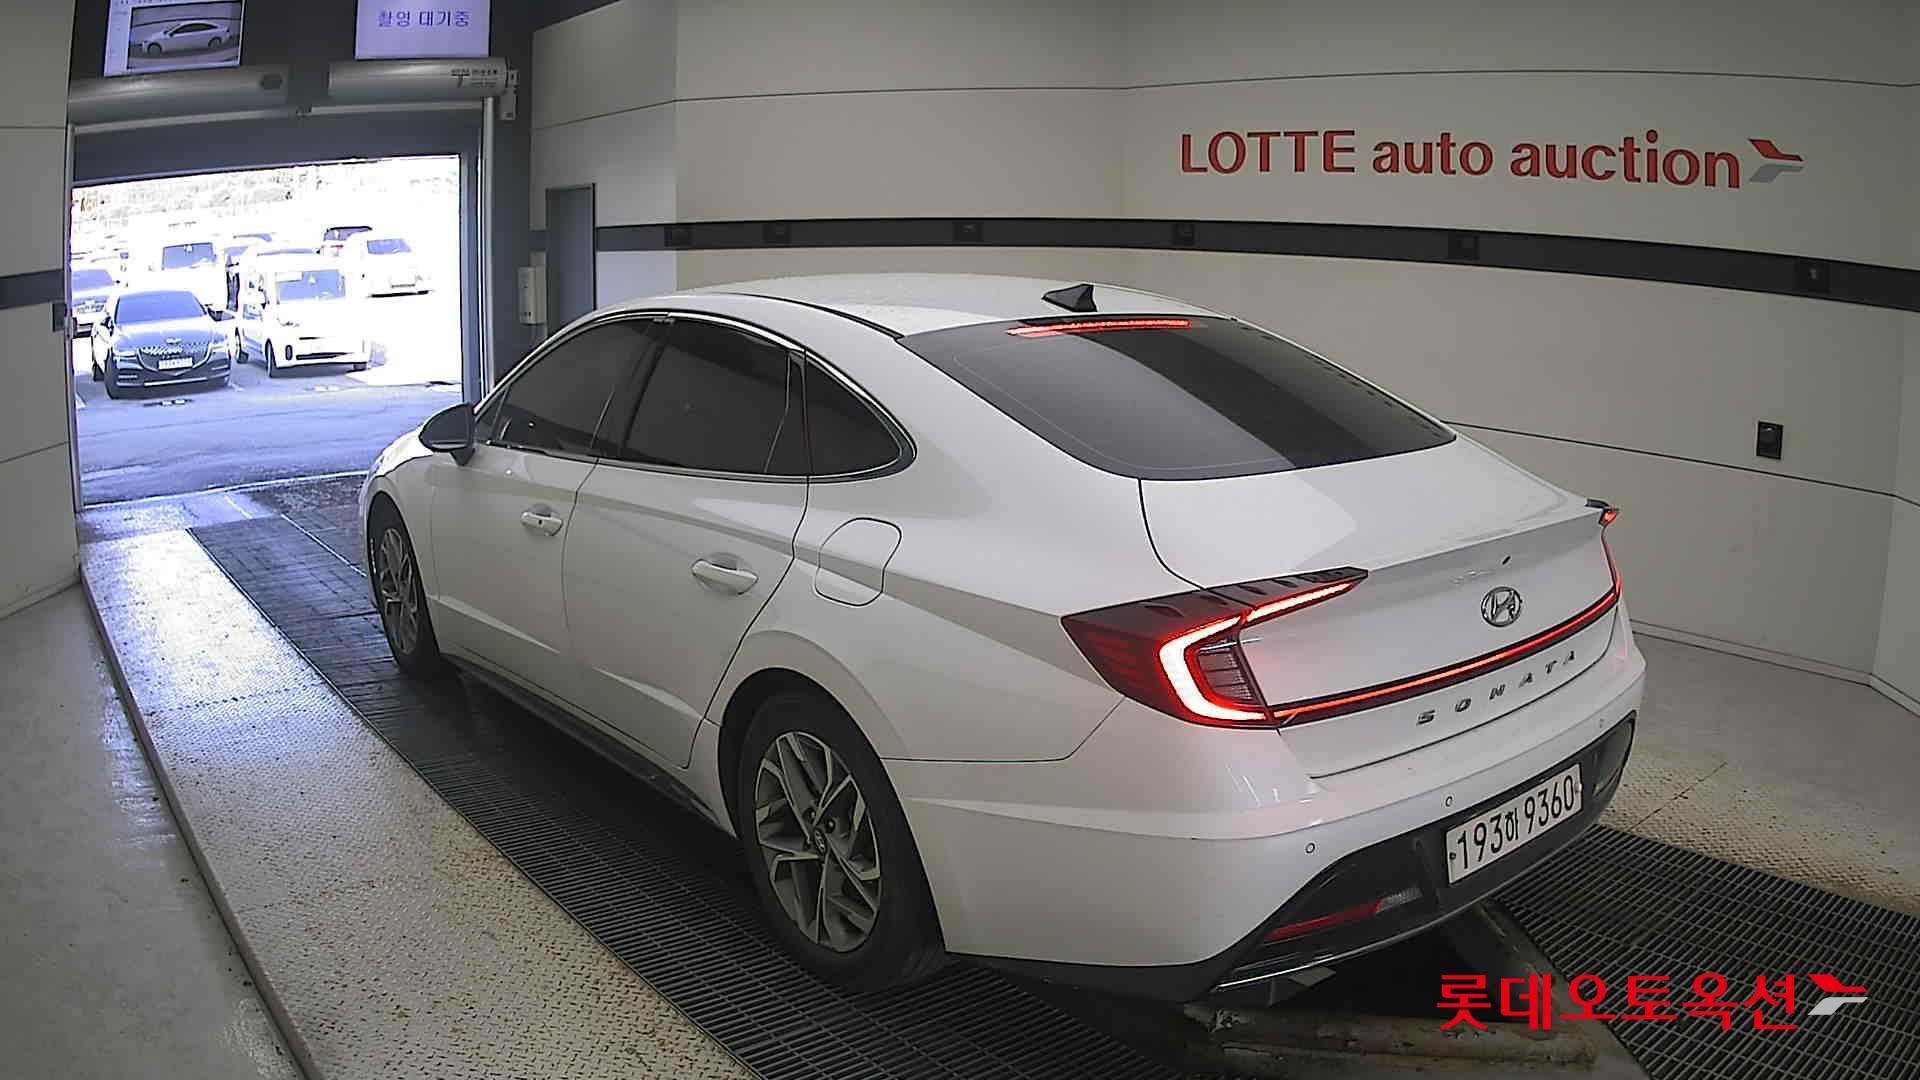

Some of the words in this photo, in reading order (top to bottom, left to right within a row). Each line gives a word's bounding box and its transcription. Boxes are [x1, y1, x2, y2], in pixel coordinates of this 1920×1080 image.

[418, 9, 470, 28] 대기중
[1180, 130, 1356, 173] LOTTE
[1373, 132, 1493, 175] auto
[1510, 129, 1741, 188] auction
[1416, 650, 1576, 726] SONATA
